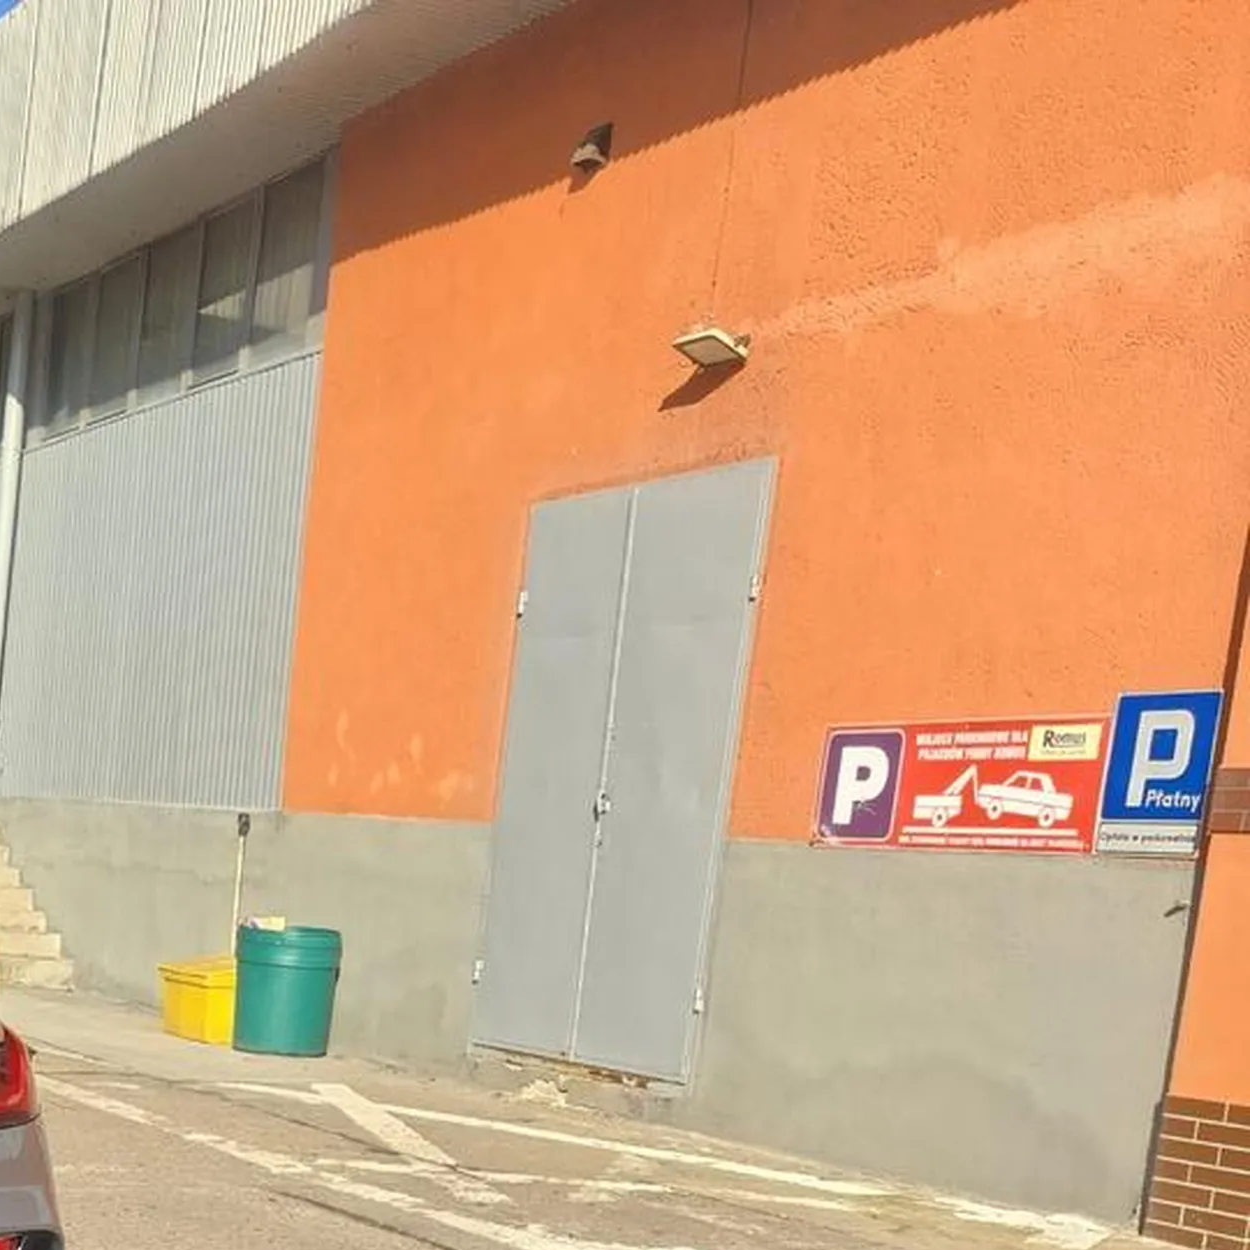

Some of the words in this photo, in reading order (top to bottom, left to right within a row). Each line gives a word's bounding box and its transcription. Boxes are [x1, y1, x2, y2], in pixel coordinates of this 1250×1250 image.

[832, 745, 890, 825] P
[1125, 709, 1195, 808] P
[1145, 788, 1201, 813] Płatny
